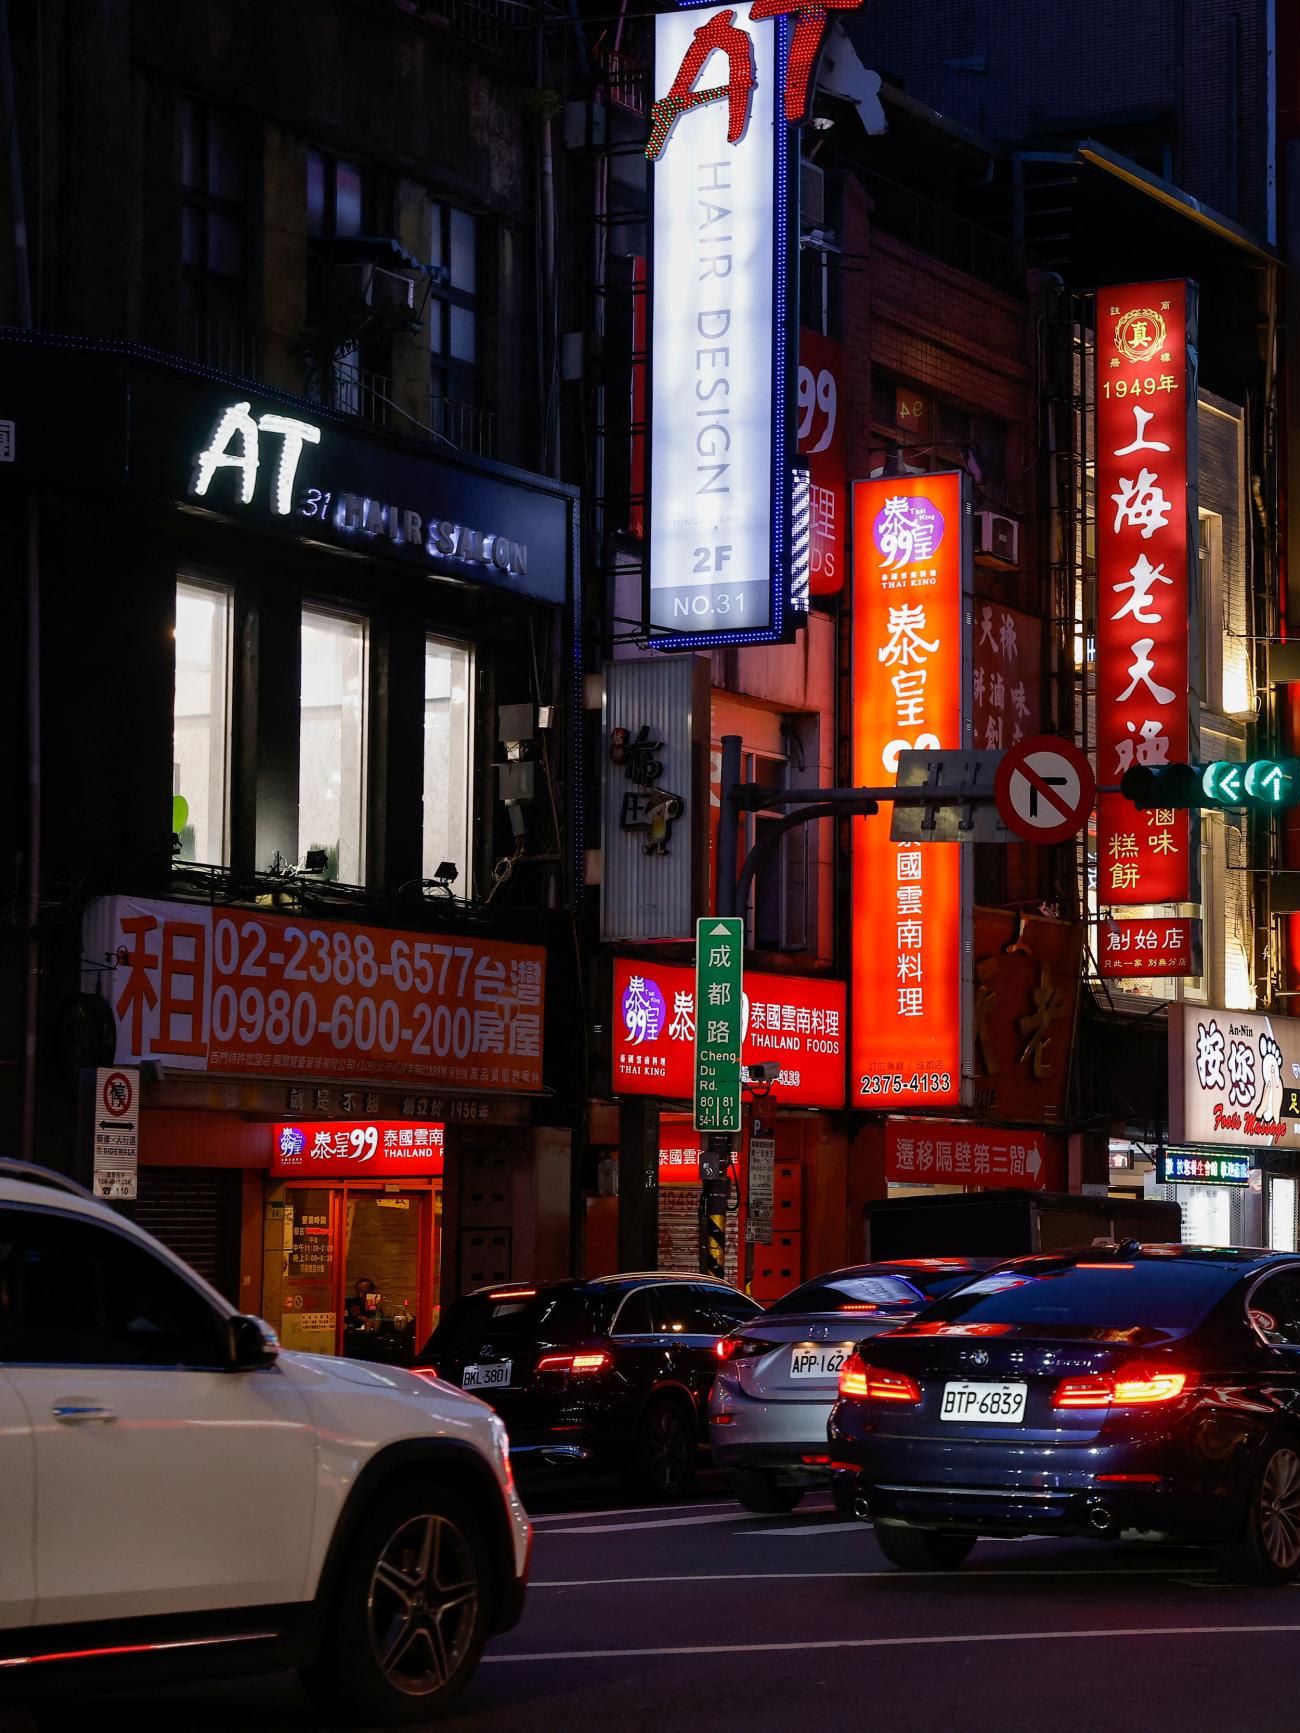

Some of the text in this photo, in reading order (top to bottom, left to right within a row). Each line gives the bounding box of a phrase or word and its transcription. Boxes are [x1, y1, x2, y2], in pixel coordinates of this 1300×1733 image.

[698, 160, 733, 282] HAIR
[1103, 374, 1179, 399] 1949年
[695, 309, 731, 495] DESIGN
[193, 401, 321, 515] AT
[302, 489, 528, 575] 31 HAIR SALON
[692, 545, 733, 574] 2F
[881, 577, 937, 589] THAI KING
[673, 592, 745, 617] NO.31
[1108, 833, 1140, 889] 糕餅
[896, 841, 924, 1016] 國雲南料理
[1107, 928, 1185, 951] 創始店
[213, 918, 474, 998] 02-2388-6577
[116, 916, 208, 1057] 租
[474, 955, 541, 1007] 台灣
[707, 945, 731, 1044] 成都路
[212, 985, 472, 1060] 0980-600-200
[751, 1002, 840, 1037] 泰國雲南料理
[471, 1008, 541, 1058] 房屋
[751, 1033, 839, 1054] THAILAND FOODS
[701, 1051, 736, 1064] Cheng
[620, 1065, 666, 1077] THAI KING
[701, 1066, 716, 1076] Du
[861, 1073, 950, 1094] 2375-4133
[701, 1082, 718, 1092] Rd.
[701, 1097, 735, 1107] 80 81
[723, 1115, 734, 1126] 61
[384, 1149, 433, 1158] THAILAND
[792, 1352, 844, 1374] APP-162
[944, 1391, 1023, 1415] BTP-6839
